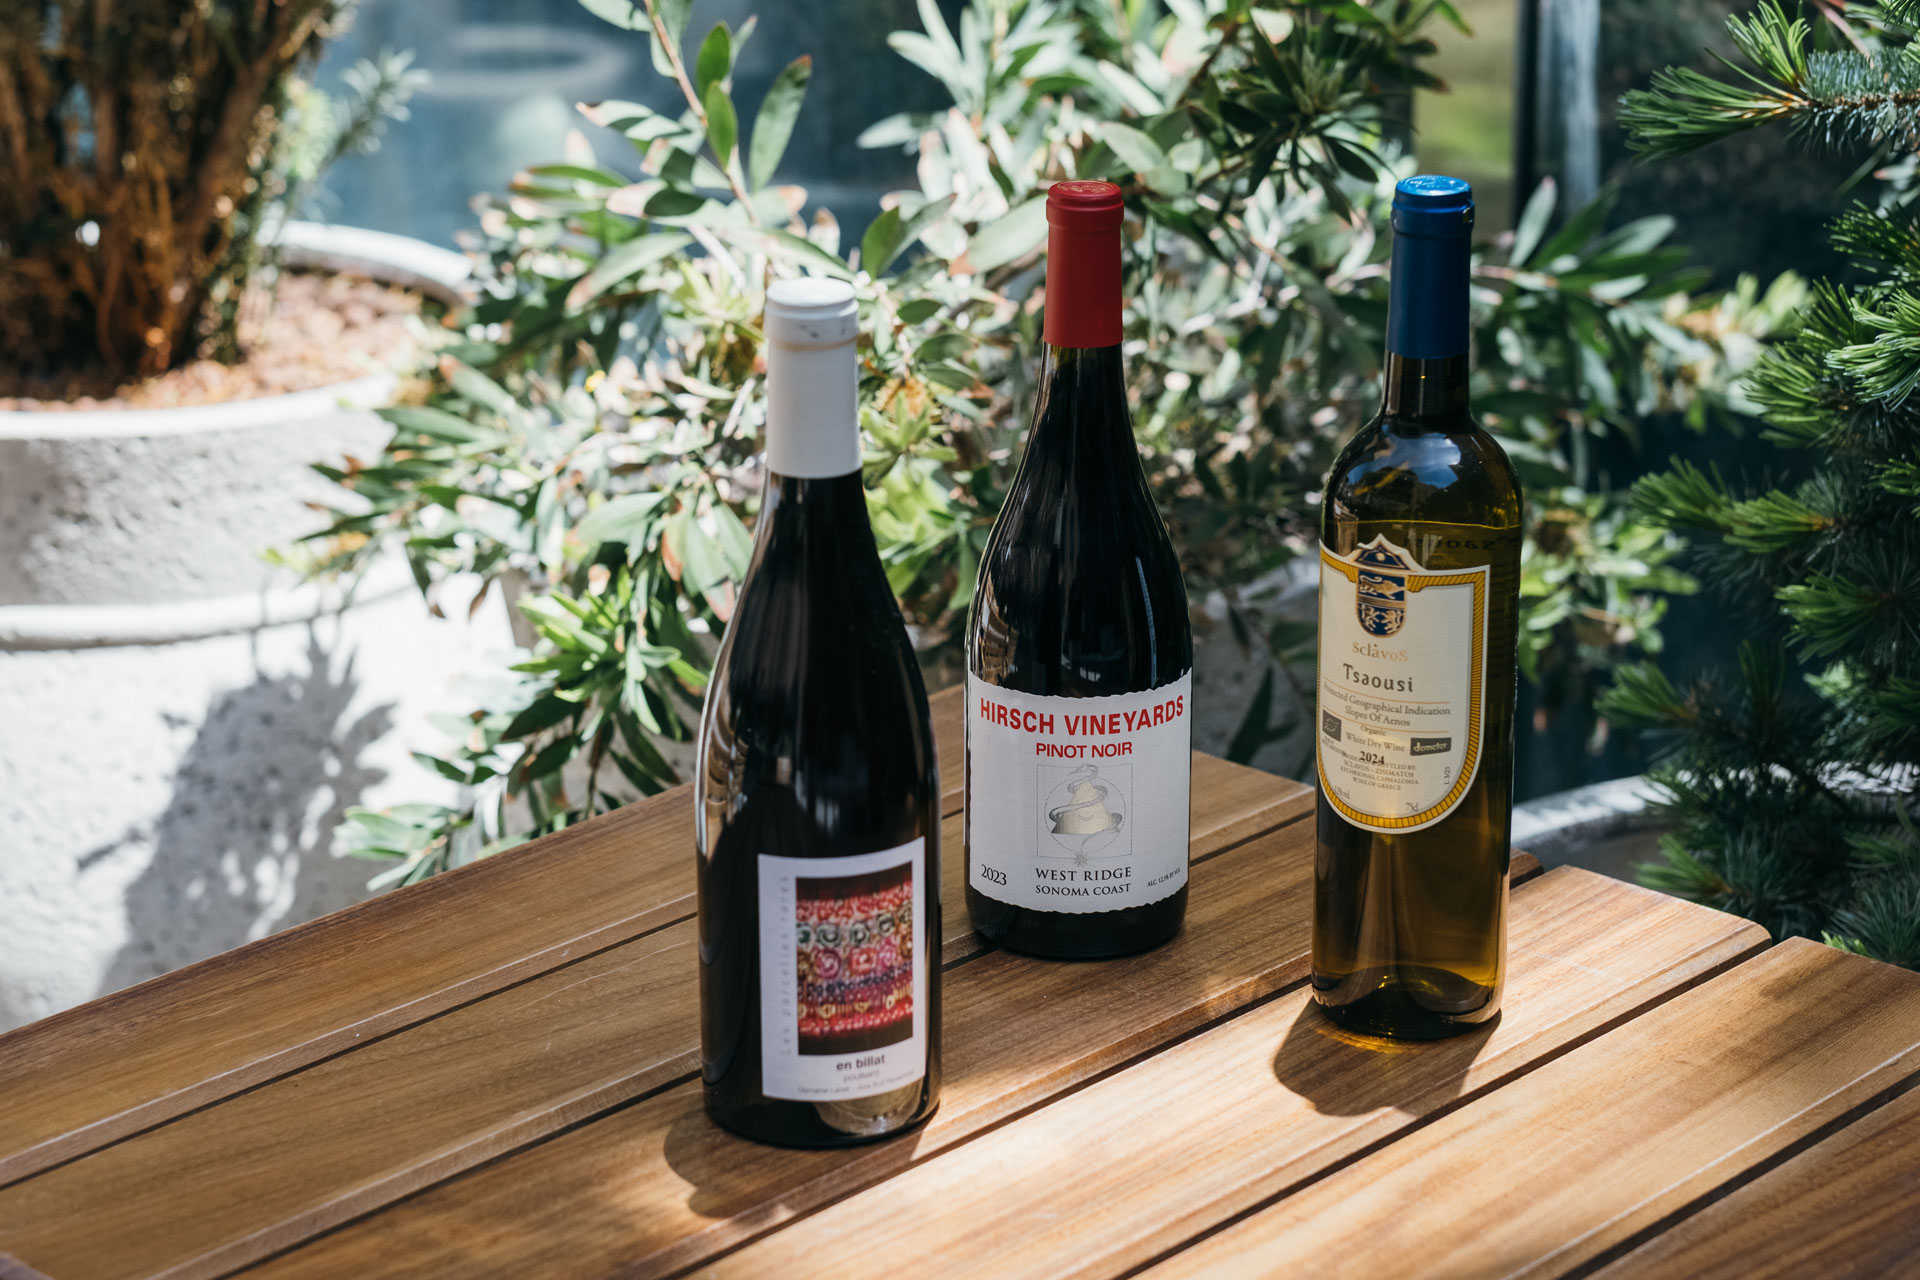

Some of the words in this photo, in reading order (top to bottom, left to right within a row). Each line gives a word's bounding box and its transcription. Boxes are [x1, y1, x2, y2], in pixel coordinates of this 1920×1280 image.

[1342, 663, 1414, 693] Tsaousi
[1349, 695, 1404, 715] Geographical
[1404, 702, 1451, 716] Indication
[980, 697, 1054, 735] HIRSCH
[1064, 694, 1184, 736] VINEYARDS
[1344, 705, 1368, 721] Slopes
[1369, 712, 1382, 723] Of
[1382, 714, 1411, 727] Aenos
[1360, 724, 1387, 738] Organic
[1036, 742, 1087, 759] PINOT
[1091, 741, 1133, 759] NOIR
[1345, 731, 1366, 746] White
[1367, 738, 1382, 751] Dry
[1383, 741, 1406, 752] Wine
[1412, 741, 1448, 754] demeter
[1359, 750, 1386, 765] 2024
[981, 864, 1008, 887] 2023
[1035, 867, 1078, 882] WEST
[1084, 866, 1132, 882] RIDGE
[1035, 884, 1090, 897] SONOMA
[1093, 883, 1132, 897] COAST
[836, 1061, 852, 1072] en
[855, 1054, 886, 1070] billat
